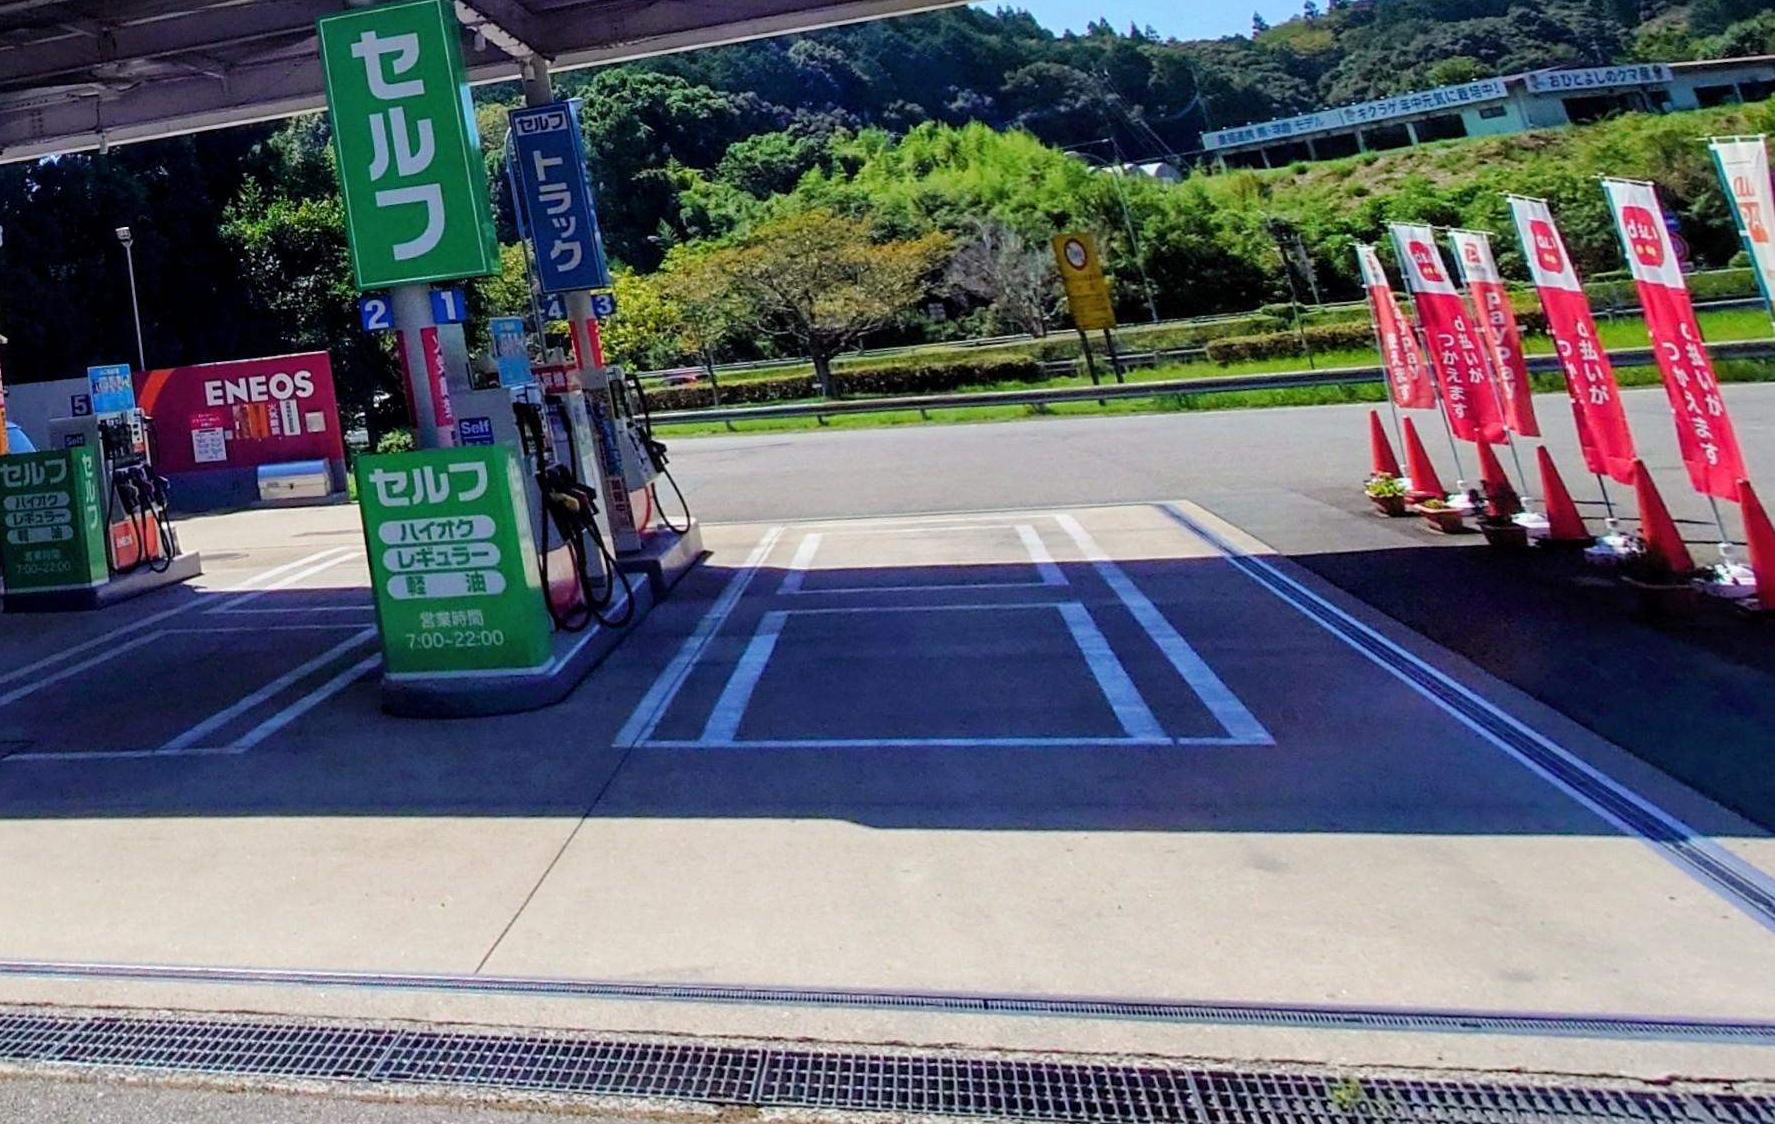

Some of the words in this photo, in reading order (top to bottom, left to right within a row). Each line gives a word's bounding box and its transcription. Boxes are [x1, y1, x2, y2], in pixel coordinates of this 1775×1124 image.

[517, 112, 564, 133] セルフ
[351, 30, 446, 262] セルフ
[533, 149, 583, 273] トラック
[364, 299, 389, 329] 2
[440, 289, 457, 320] 1
[597, 295, 613, 314] 3
[1454, 316, 1485, 384] d払いが
[1485, 291, 1516, 400] PayPay
[204, 370, 314, 407] ENEOS
[1437, 333, 1467, 419] つかえます
[73, 395, 88, 415] 5
[1662, 341, 1719, 466] つかえます
[460, 419, 490, 435] Self
[0, 458, 68, 488] セルフ
[369, 461, 488, 507] セルフ
[15, 494, 59, 509] ハイオク
[82, 453, 99, 530] セルフ
[13, 510, 66, 525] レギュラー
[400, 519, 474, 541] ハイオク
[397, 546, 489, 569] レギュラー
[419, 608, 484, 628] 営業時間
